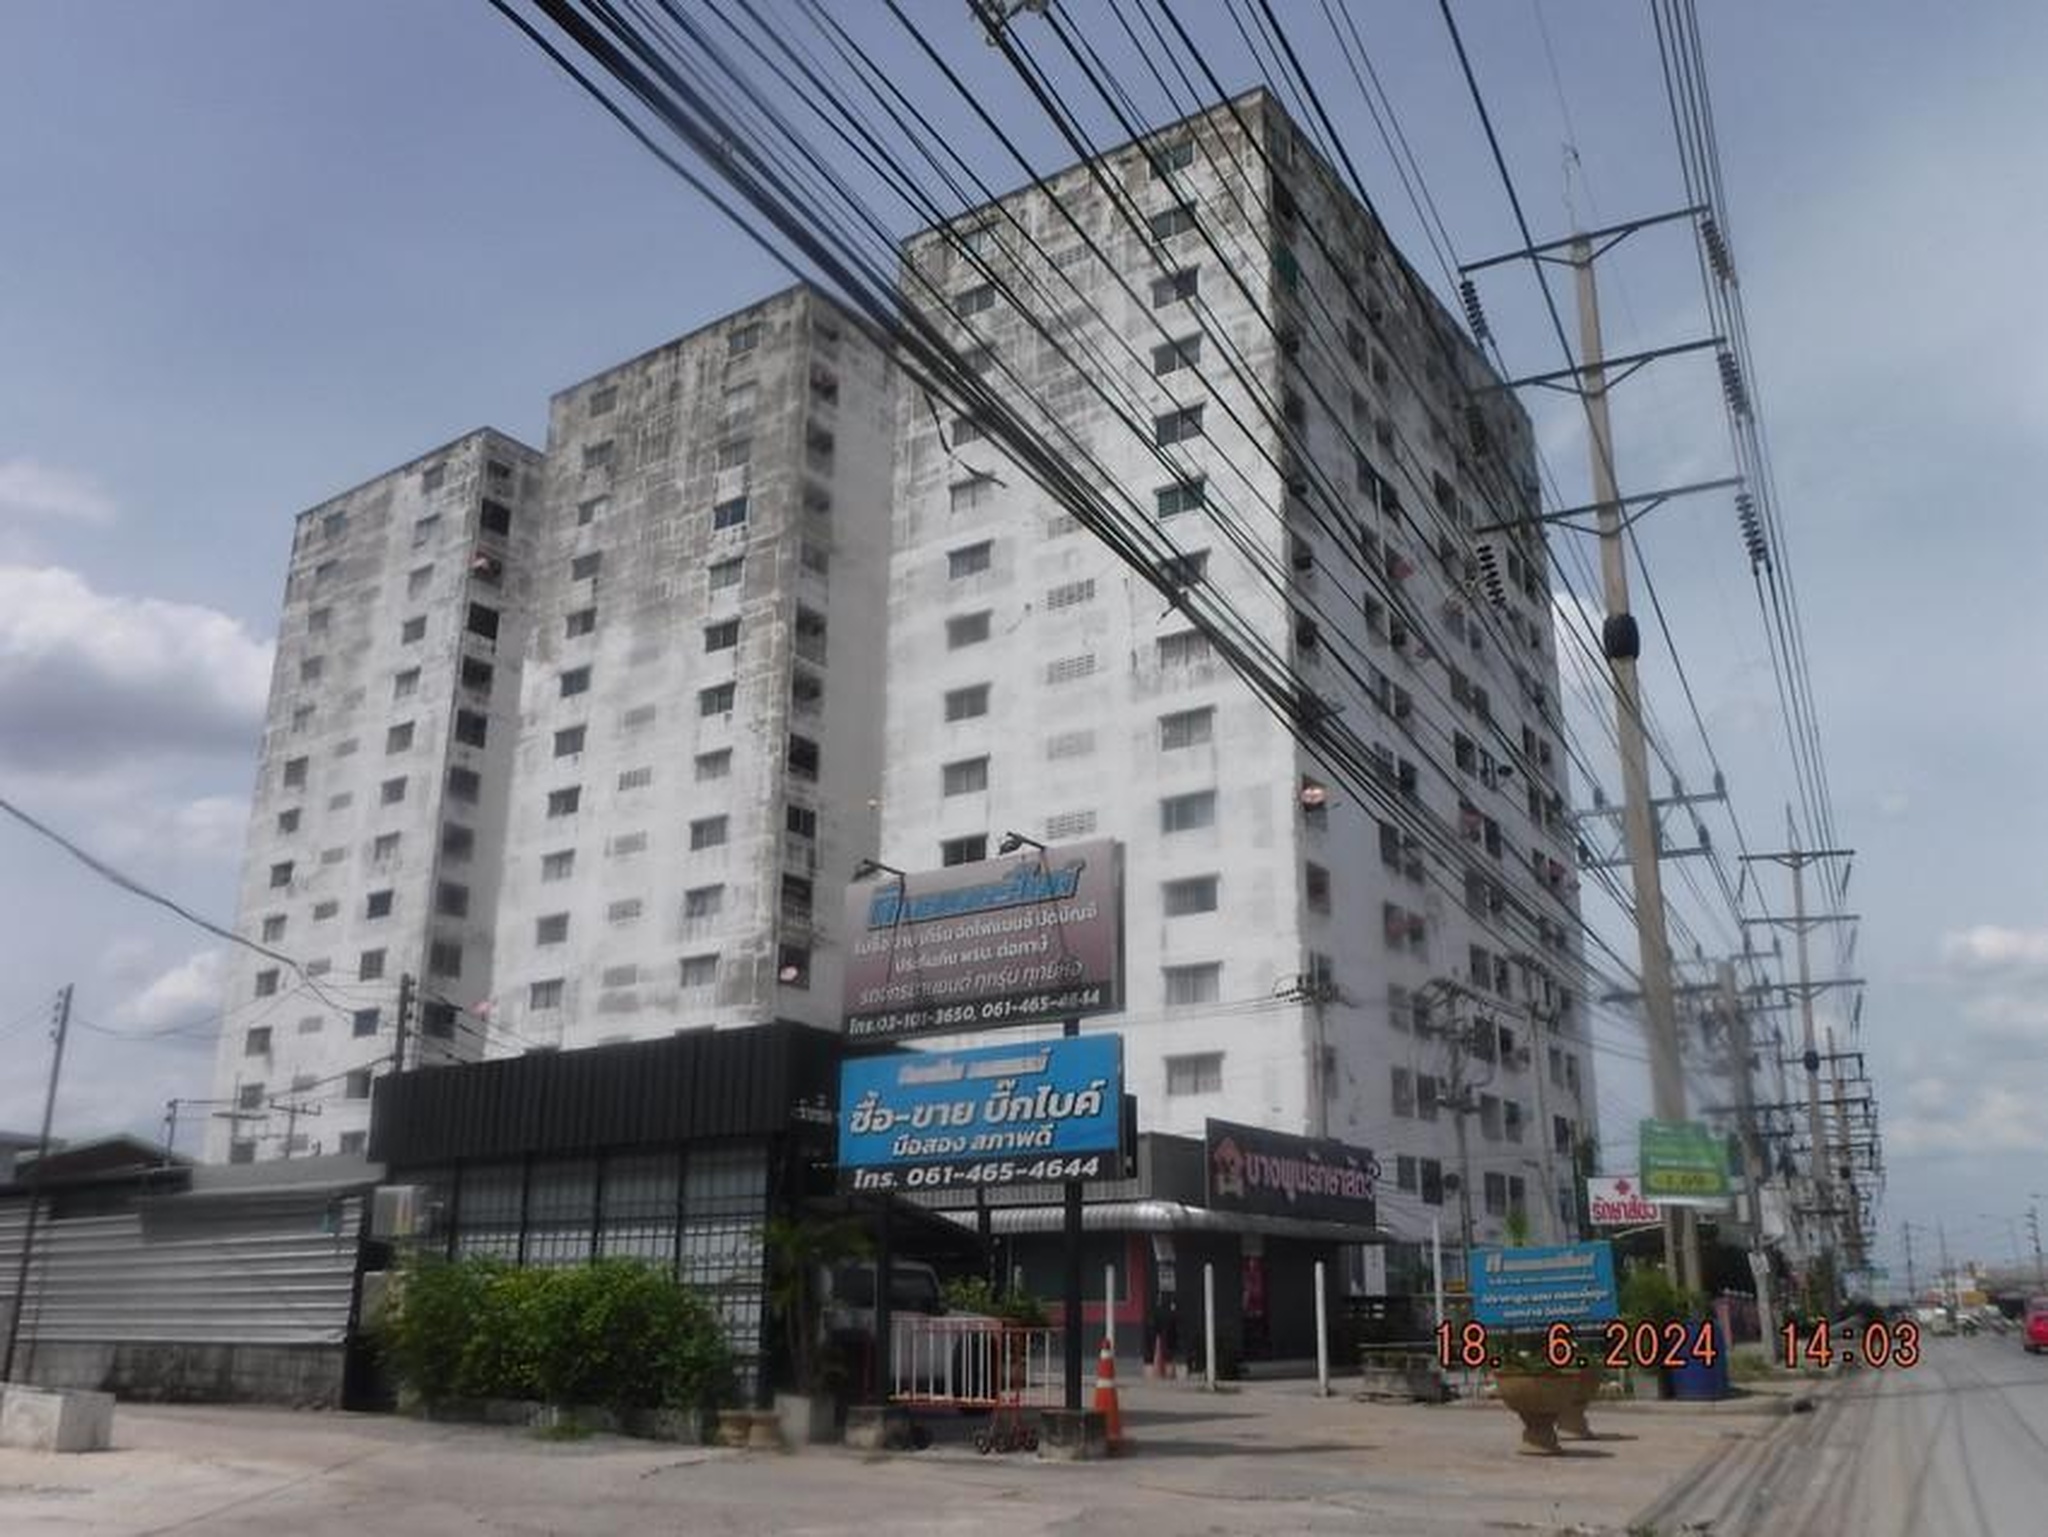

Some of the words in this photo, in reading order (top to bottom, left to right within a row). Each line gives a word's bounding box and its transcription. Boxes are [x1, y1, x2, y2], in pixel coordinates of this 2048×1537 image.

[970, 1124, 1055, 1150] สภาพดี
[906, 1156, 1099, 1187] 061-465-4644
